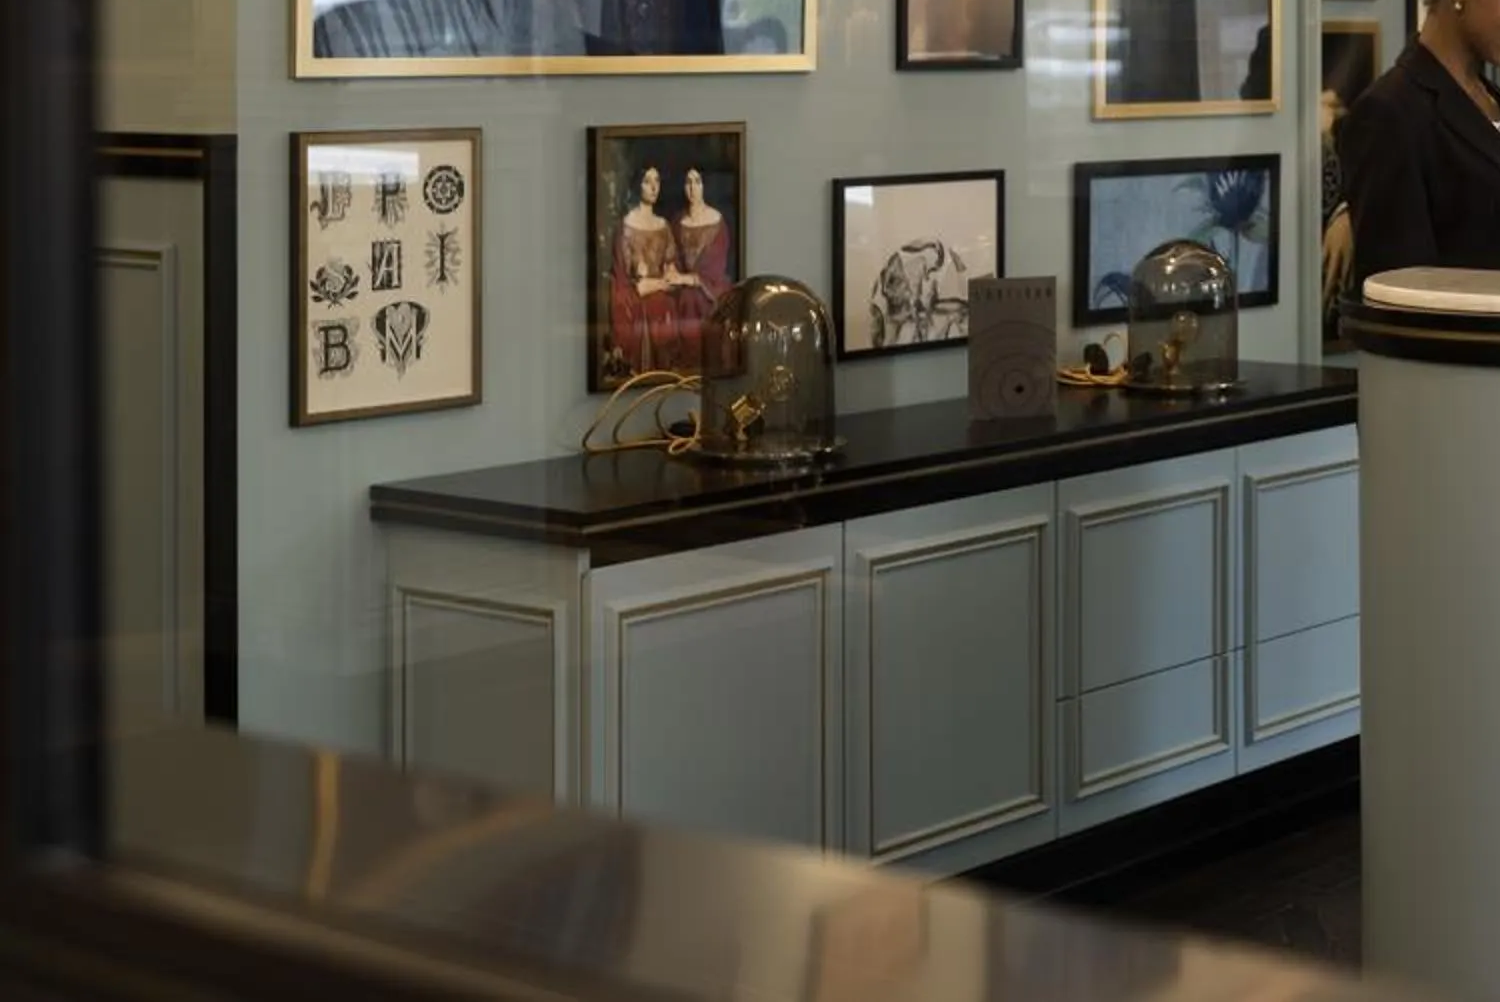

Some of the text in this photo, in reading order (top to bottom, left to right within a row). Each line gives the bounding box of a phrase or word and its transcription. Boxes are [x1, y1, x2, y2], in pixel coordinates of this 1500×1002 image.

[374, 242, 401, 289] A
[318, 303, 419, 376] B M
